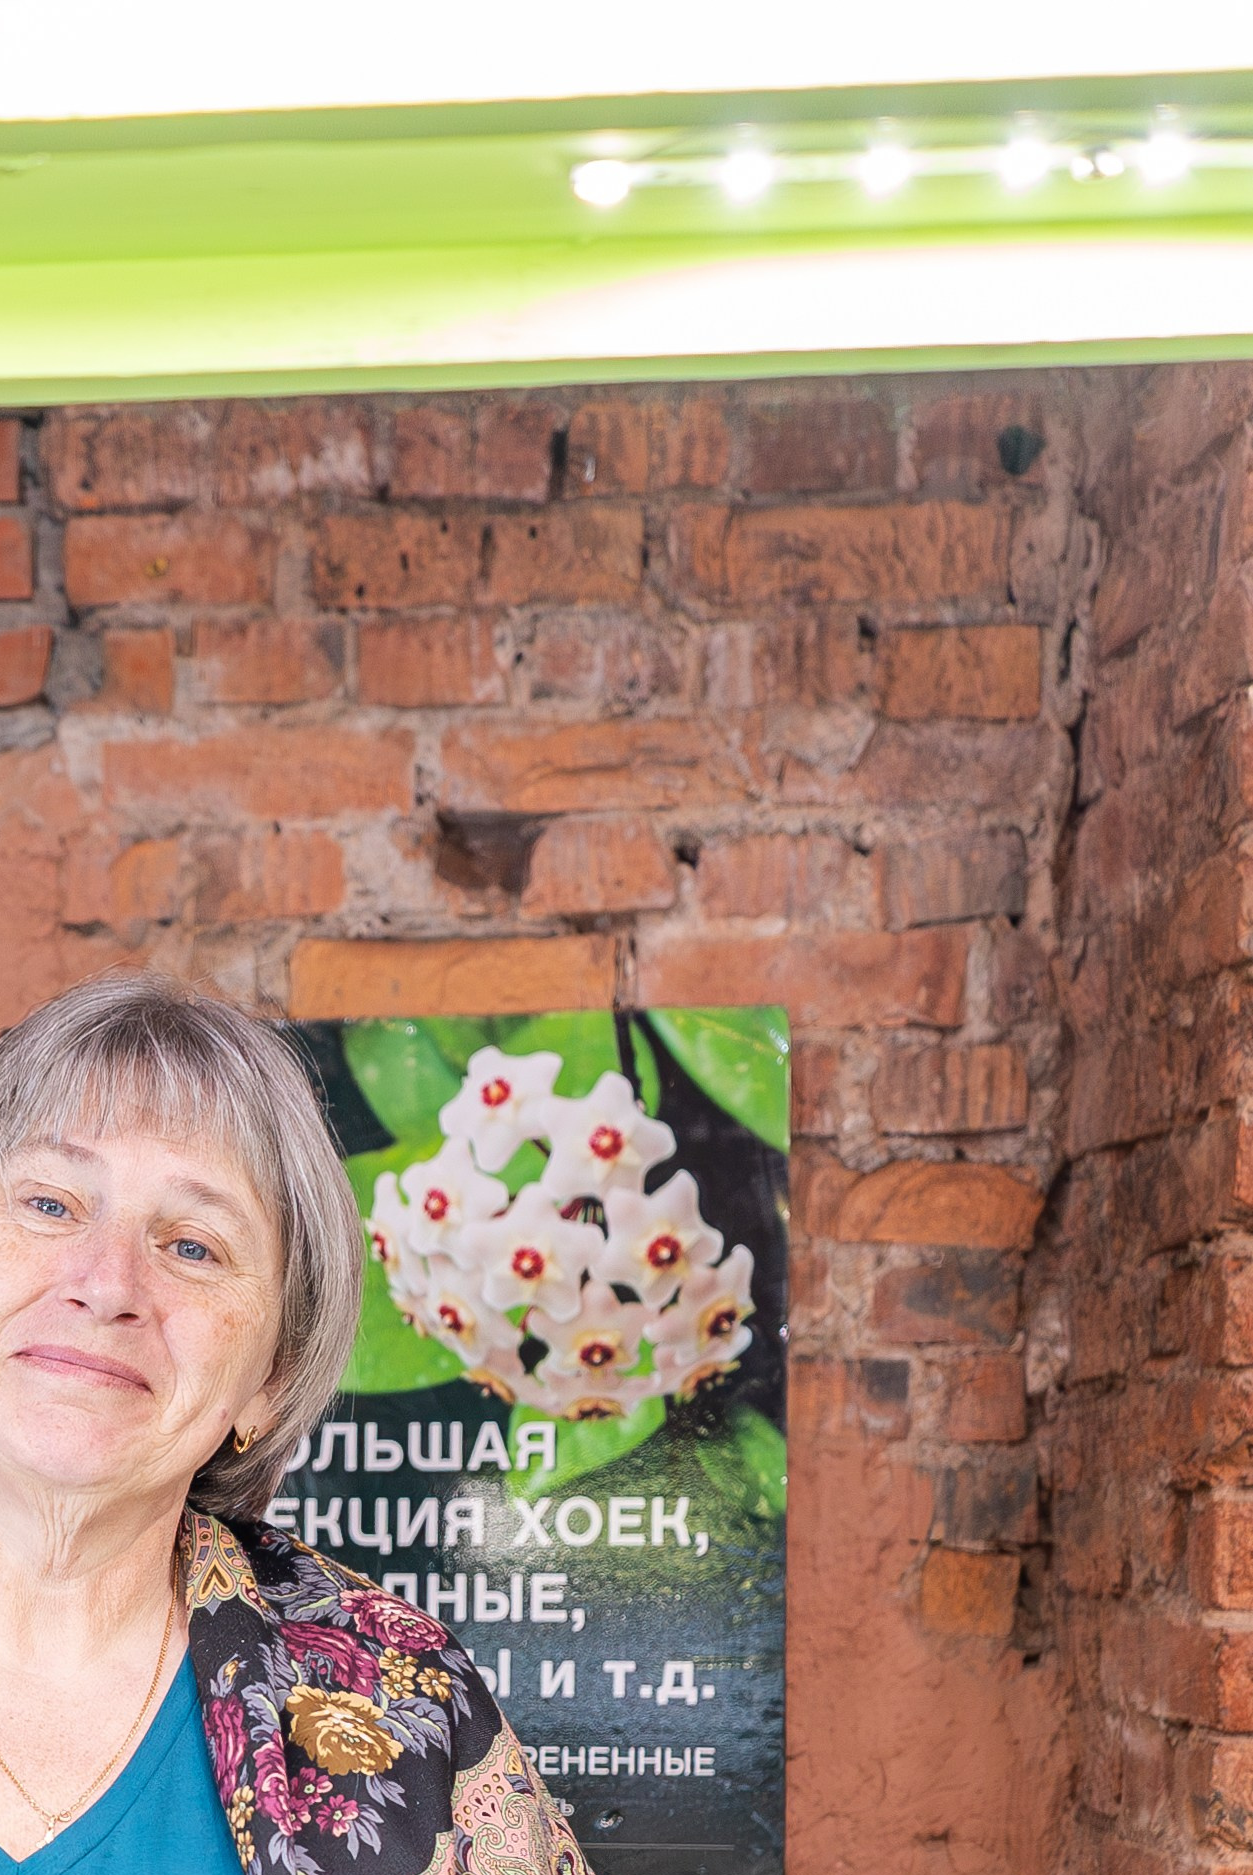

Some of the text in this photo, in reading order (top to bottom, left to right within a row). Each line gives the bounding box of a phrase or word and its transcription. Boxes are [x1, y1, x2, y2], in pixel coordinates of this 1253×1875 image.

[513, 1496, 710, 1557] ХОЕК,
[540, 1660, 576, 1699] и
[602, 1660, 715, 1705] т.д.
